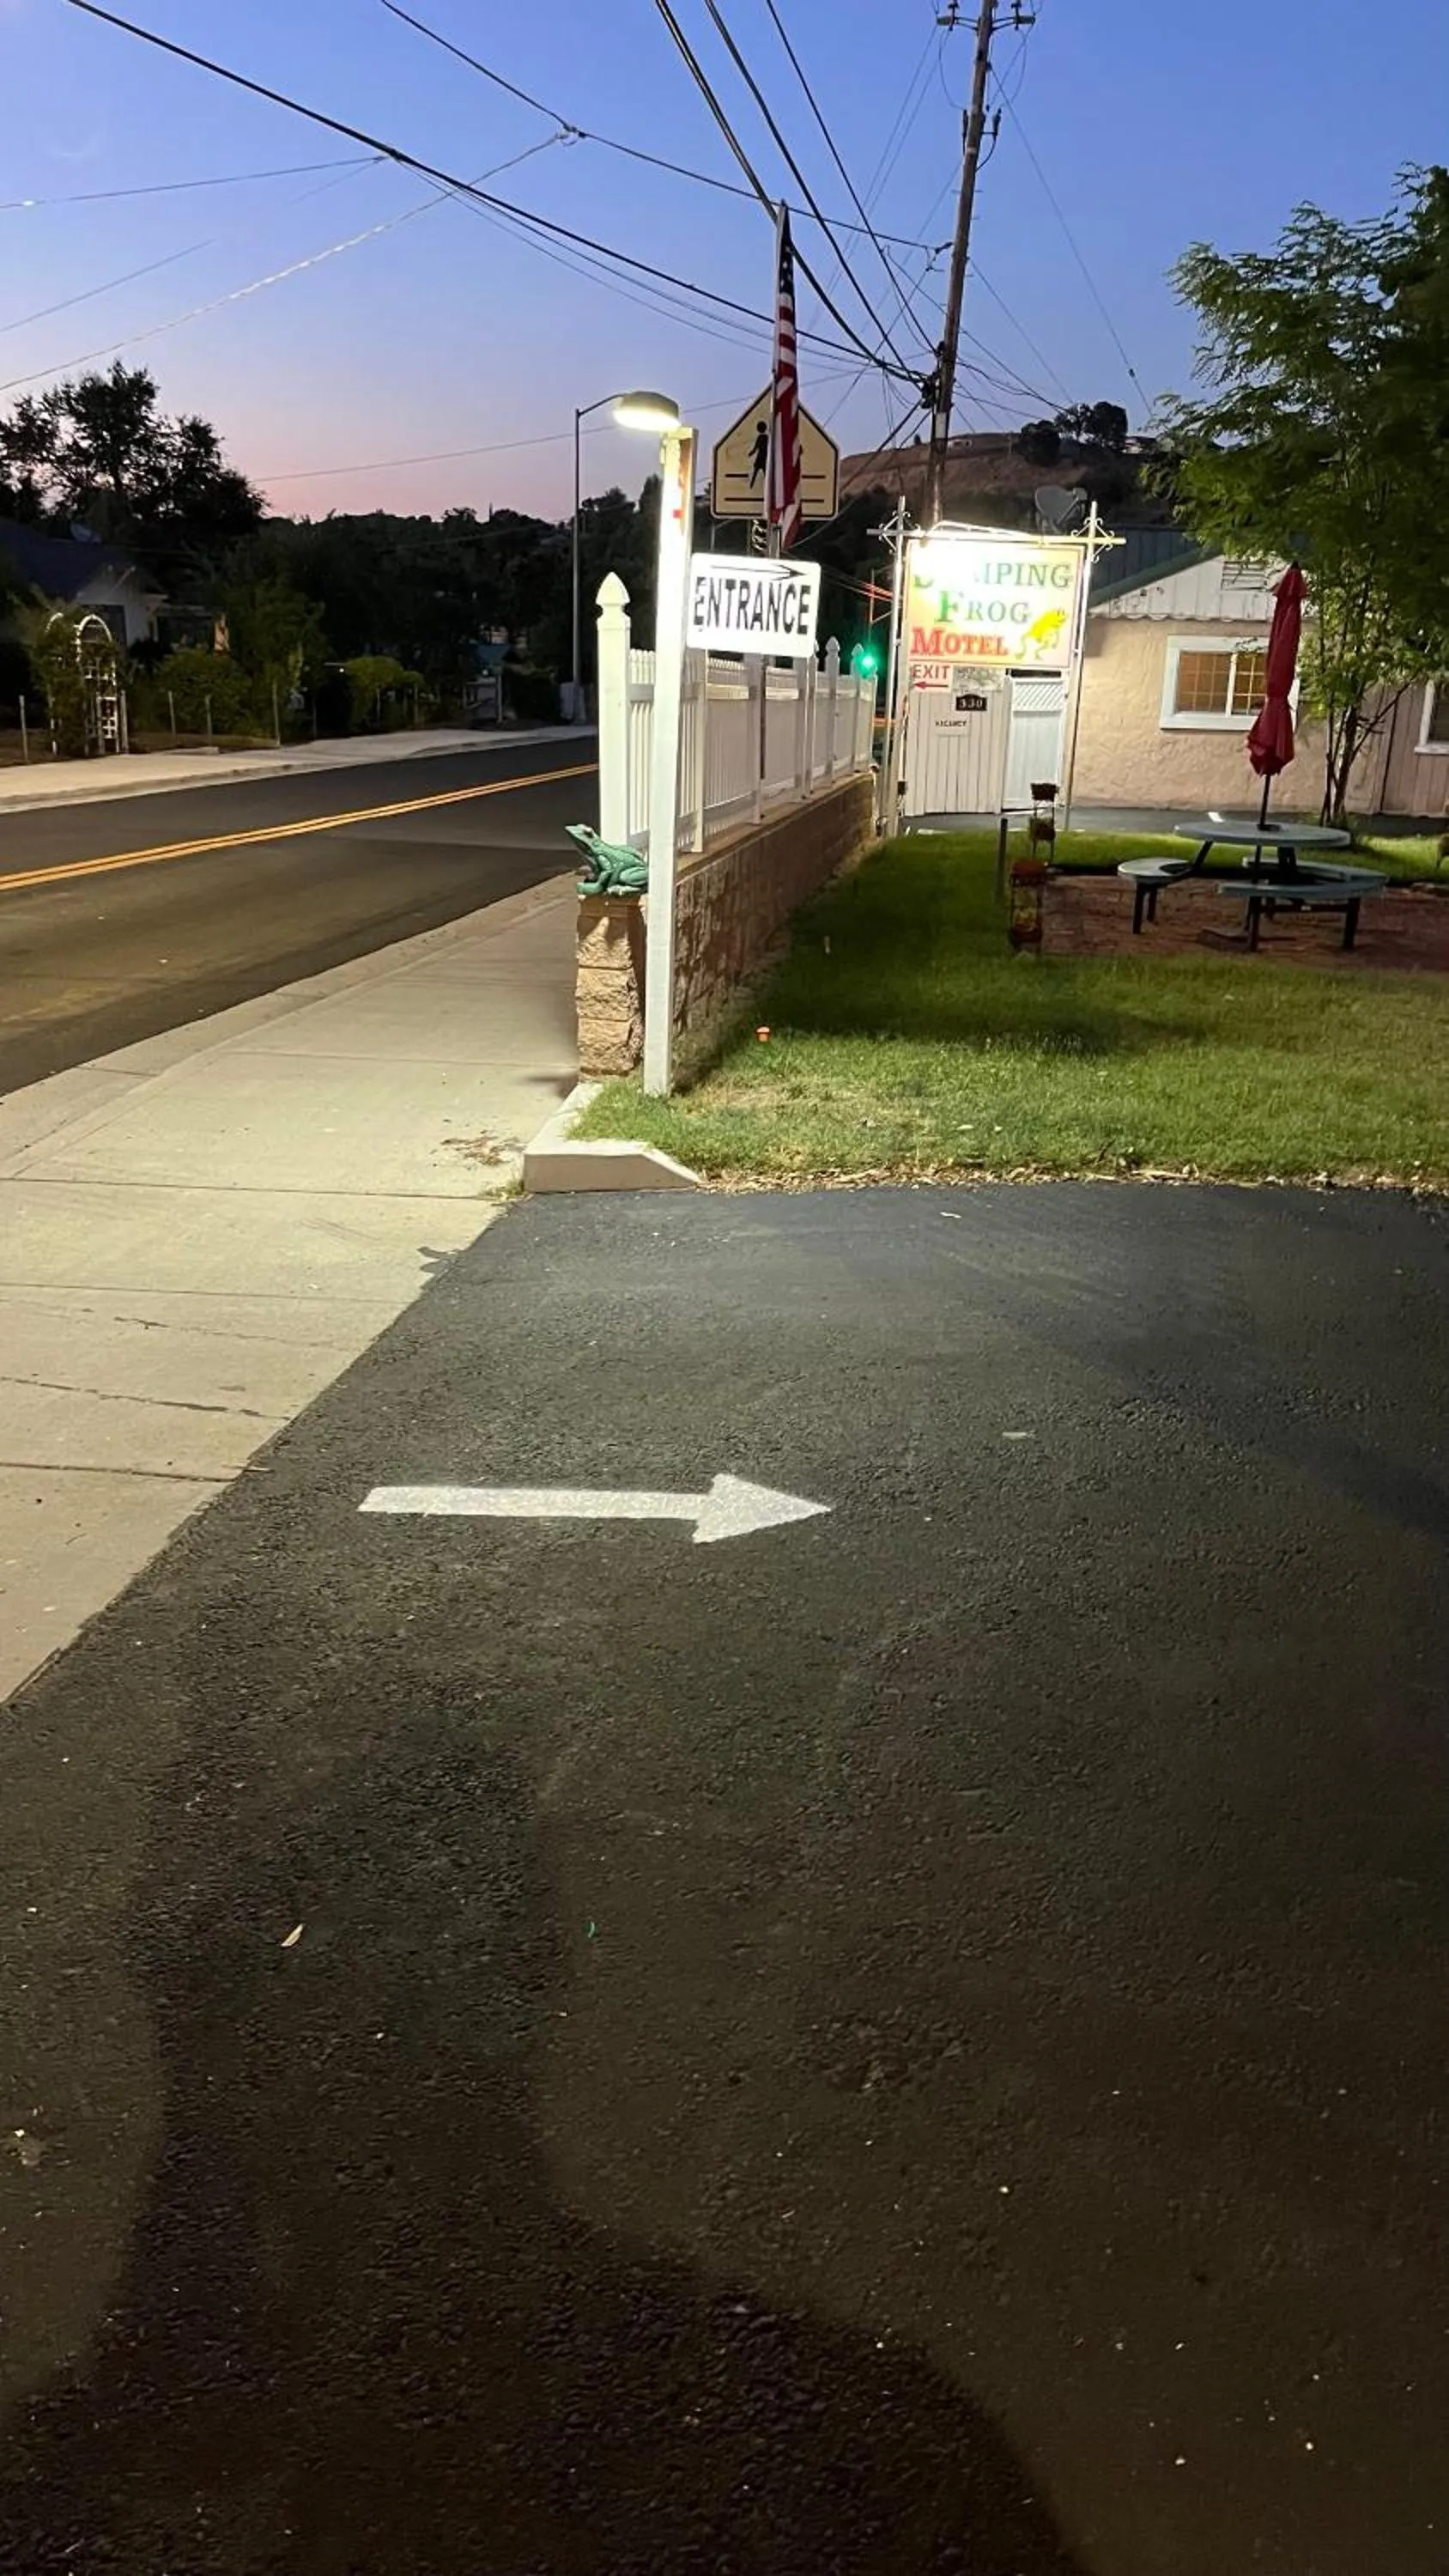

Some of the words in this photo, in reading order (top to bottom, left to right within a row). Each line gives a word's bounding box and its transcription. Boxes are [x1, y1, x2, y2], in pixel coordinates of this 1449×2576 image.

[912, 562, 1074, 590] PING
[693, 576, 811, 635] ENTRANCE
[933, 590, 1031, 623] FROG
[910, 626, 1009, 657] MOTEL
[911, 664, 950, 679] EXIT
